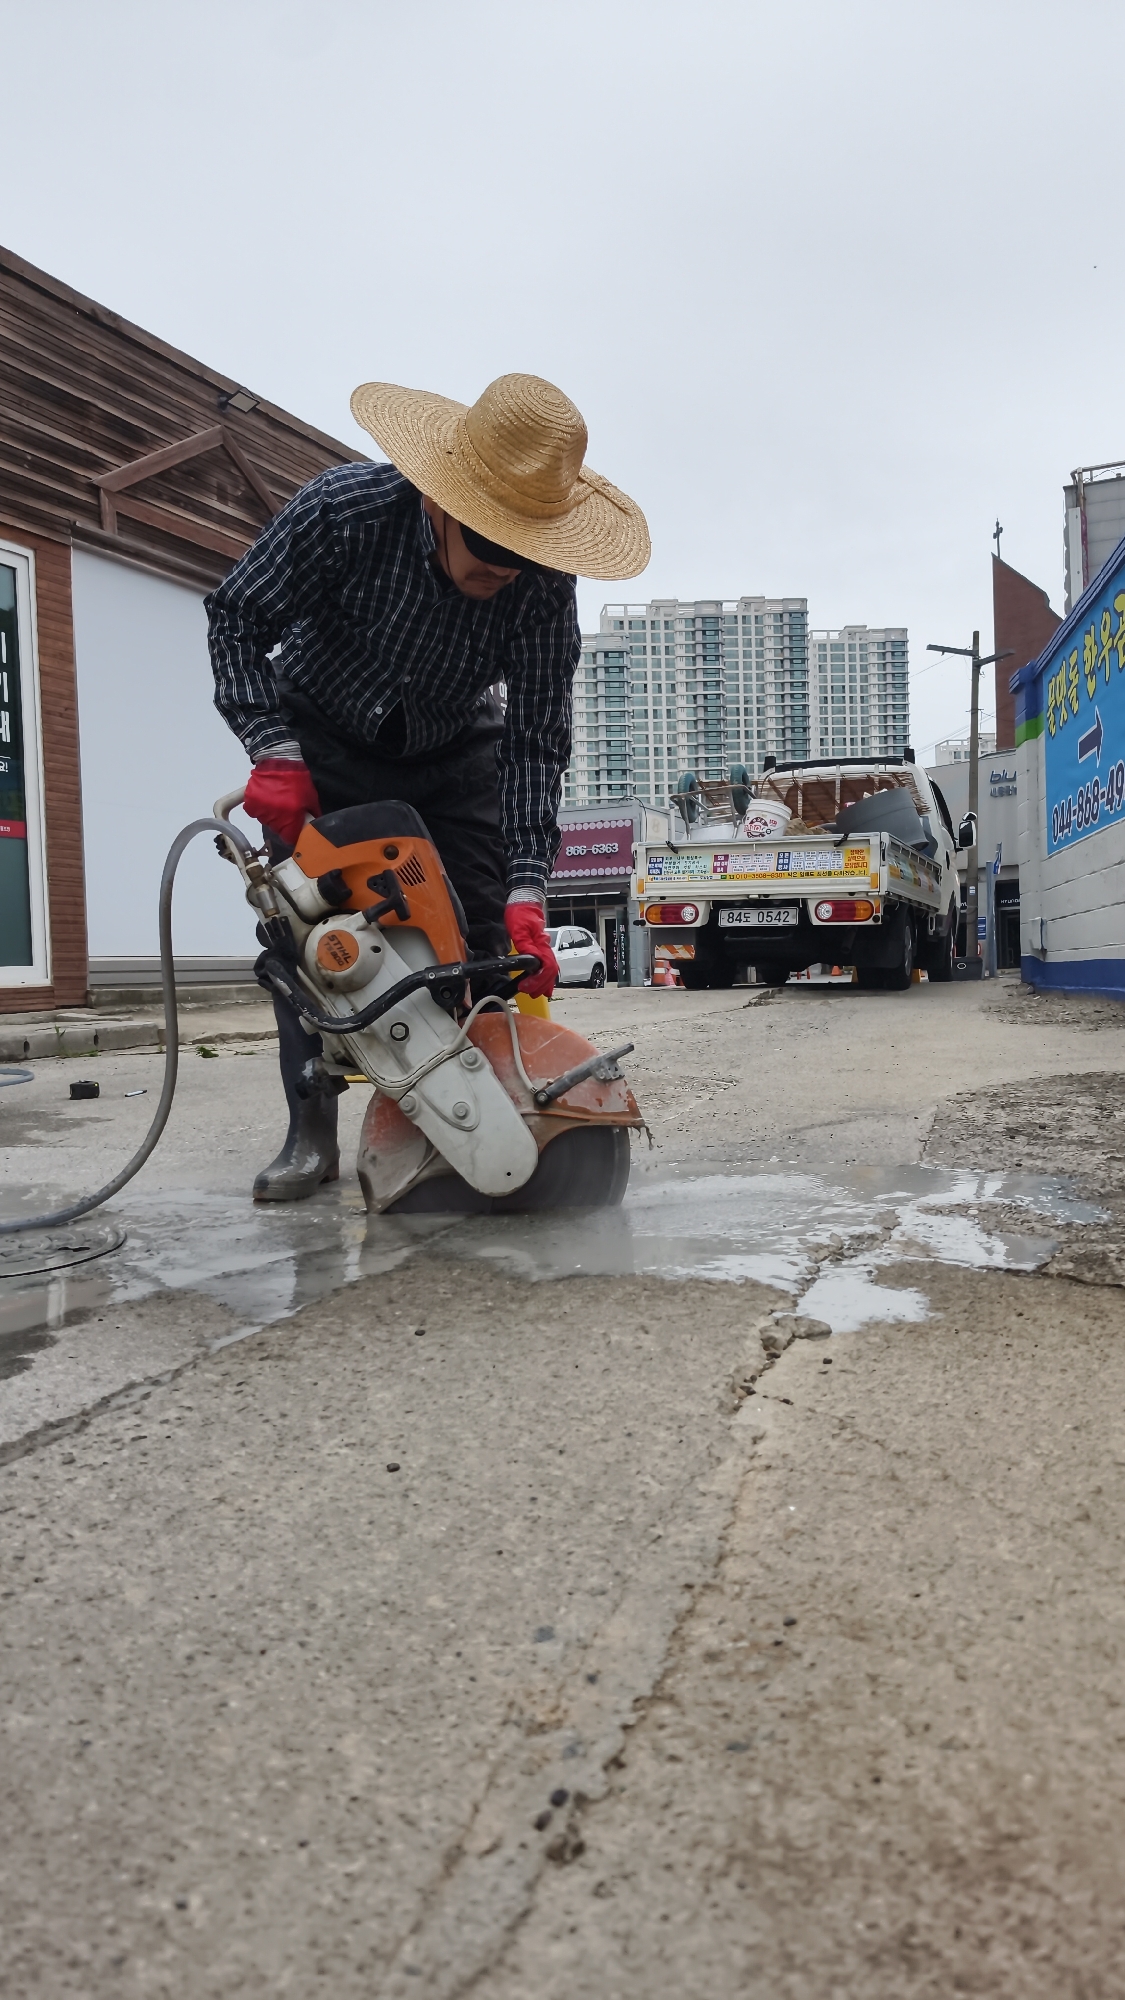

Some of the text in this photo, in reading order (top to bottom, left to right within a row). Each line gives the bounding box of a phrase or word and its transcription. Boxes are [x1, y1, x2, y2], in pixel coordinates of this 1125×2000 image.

[1052, 759, 1125, 845] 044-868-49
[565, 842, 619, 857] 866-6363
[757, 910, 790, 923] 0542
[327, 934, 352, 964] STIHL
